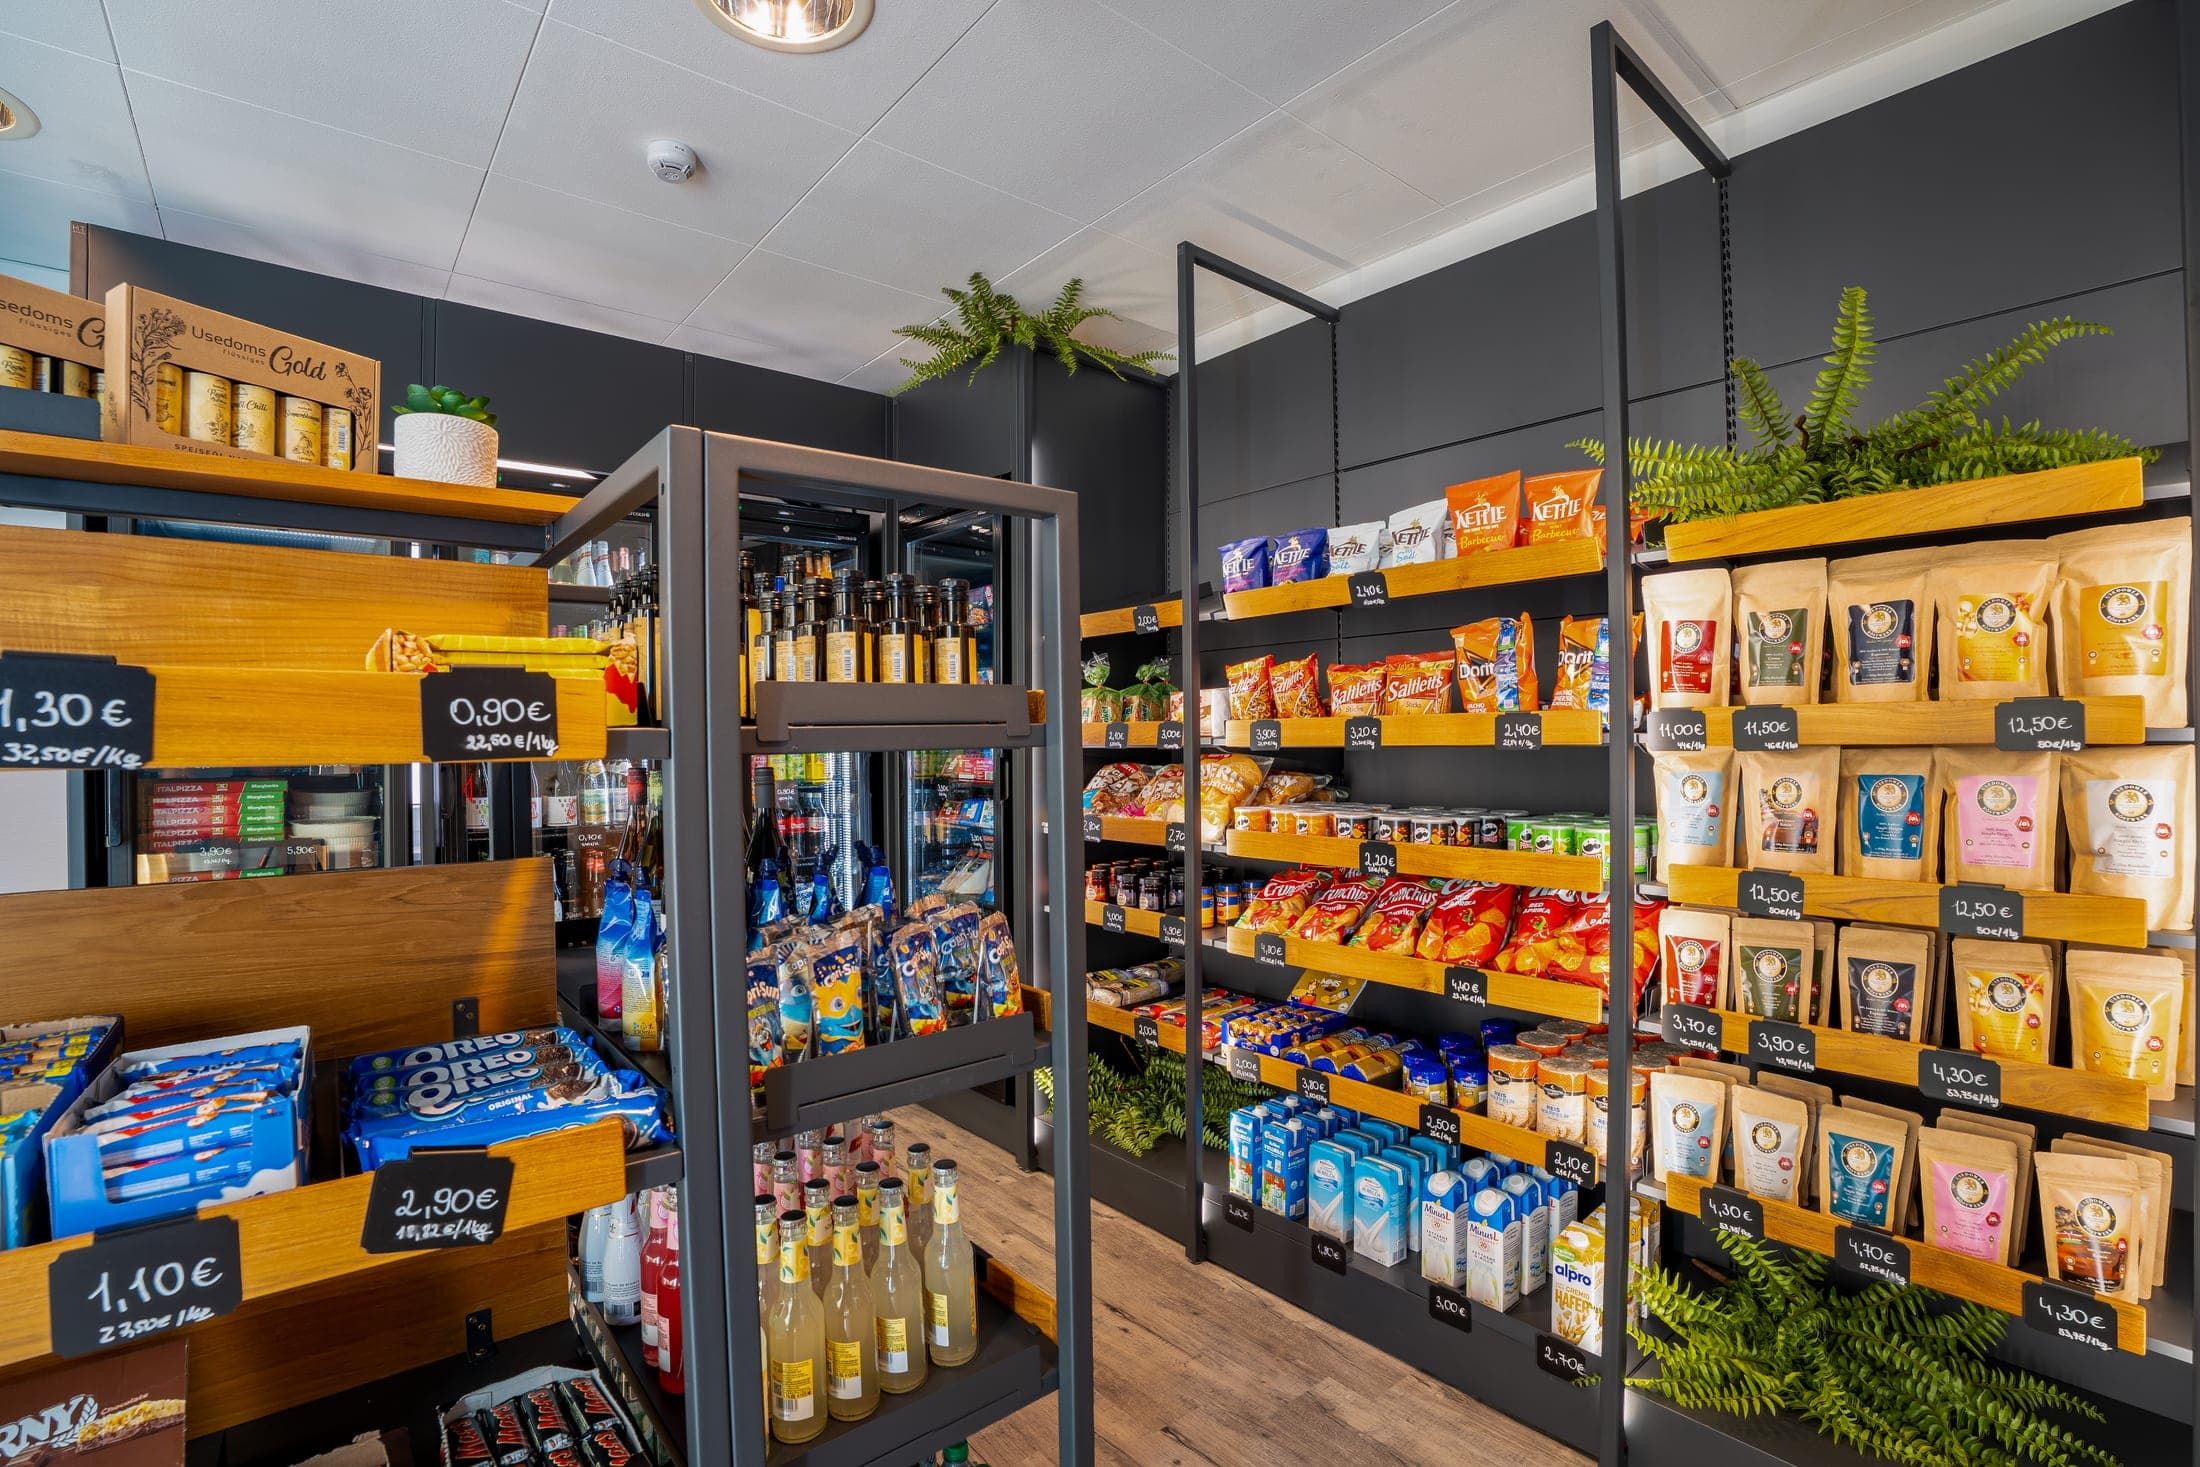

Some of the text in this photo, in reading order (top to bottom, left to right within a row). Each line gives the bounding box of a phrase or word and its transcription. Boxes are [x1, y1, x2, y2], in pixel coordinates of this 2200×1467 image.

[0, 300, 73, 329] sedoms
[191, 325, 266, 357] Usedoms
[269, 345, 328, 381] Gold
[1455, 504, 1507, 530] KETTLE
[1532, 497, 1582, 522] KETTLE
[1393, 526, 1430, 545] KETTLE
[1459, 534, 1505, 549] Barbecue
[1532, 527, 1580, 543] Barbecue
[1274, 548, 1311, 566] KETTLE
[1329, 543, 1367, 557] KETTLE
[1558, 650, 1594, 666] Dorit
[1459, 663, 1495, 680] Dorit
[1387, 674, 1444, 702] Saltletts
[450, 697, 551, 726] 0,90€
[1504, 723, 1541, 738] 2,40€
[1659, 722, 1705, 740] 11,00€
[1744, 721, 1790, 737] 11,50€
[2008, 716, 2073, 736] 12,50€
[1364, 852, 1396, 868] 2,20€
[1749, 883, 1803, 905] 12,50€
[405, 1033, 521, 1066] OREO
[408, 1051, 533, 1086] OREO
[1933, 1062, 1989, 1087] 4,30€
[408, 1068, 540, 1107] OREO
[488, 1093, 533, 1111] ORIGINAL
[1426, 1115, 1458, 1134] 2,50€
[1554, 1151, 1591, 1174] 2,10€
[395, 1187, 499, 1218] 2,90€
[1849, 1237, 1897, 1265] 4,70€
[88, 1257, 223, 1313] 1,10€
[1555, 1263, 1591, 1286] alpro
[2039, 1296, 2106, 1329] 4,30€
[1544, 1346, 1586, 1376] 2,70€
[0, 1395, 85, 1458] RNY
